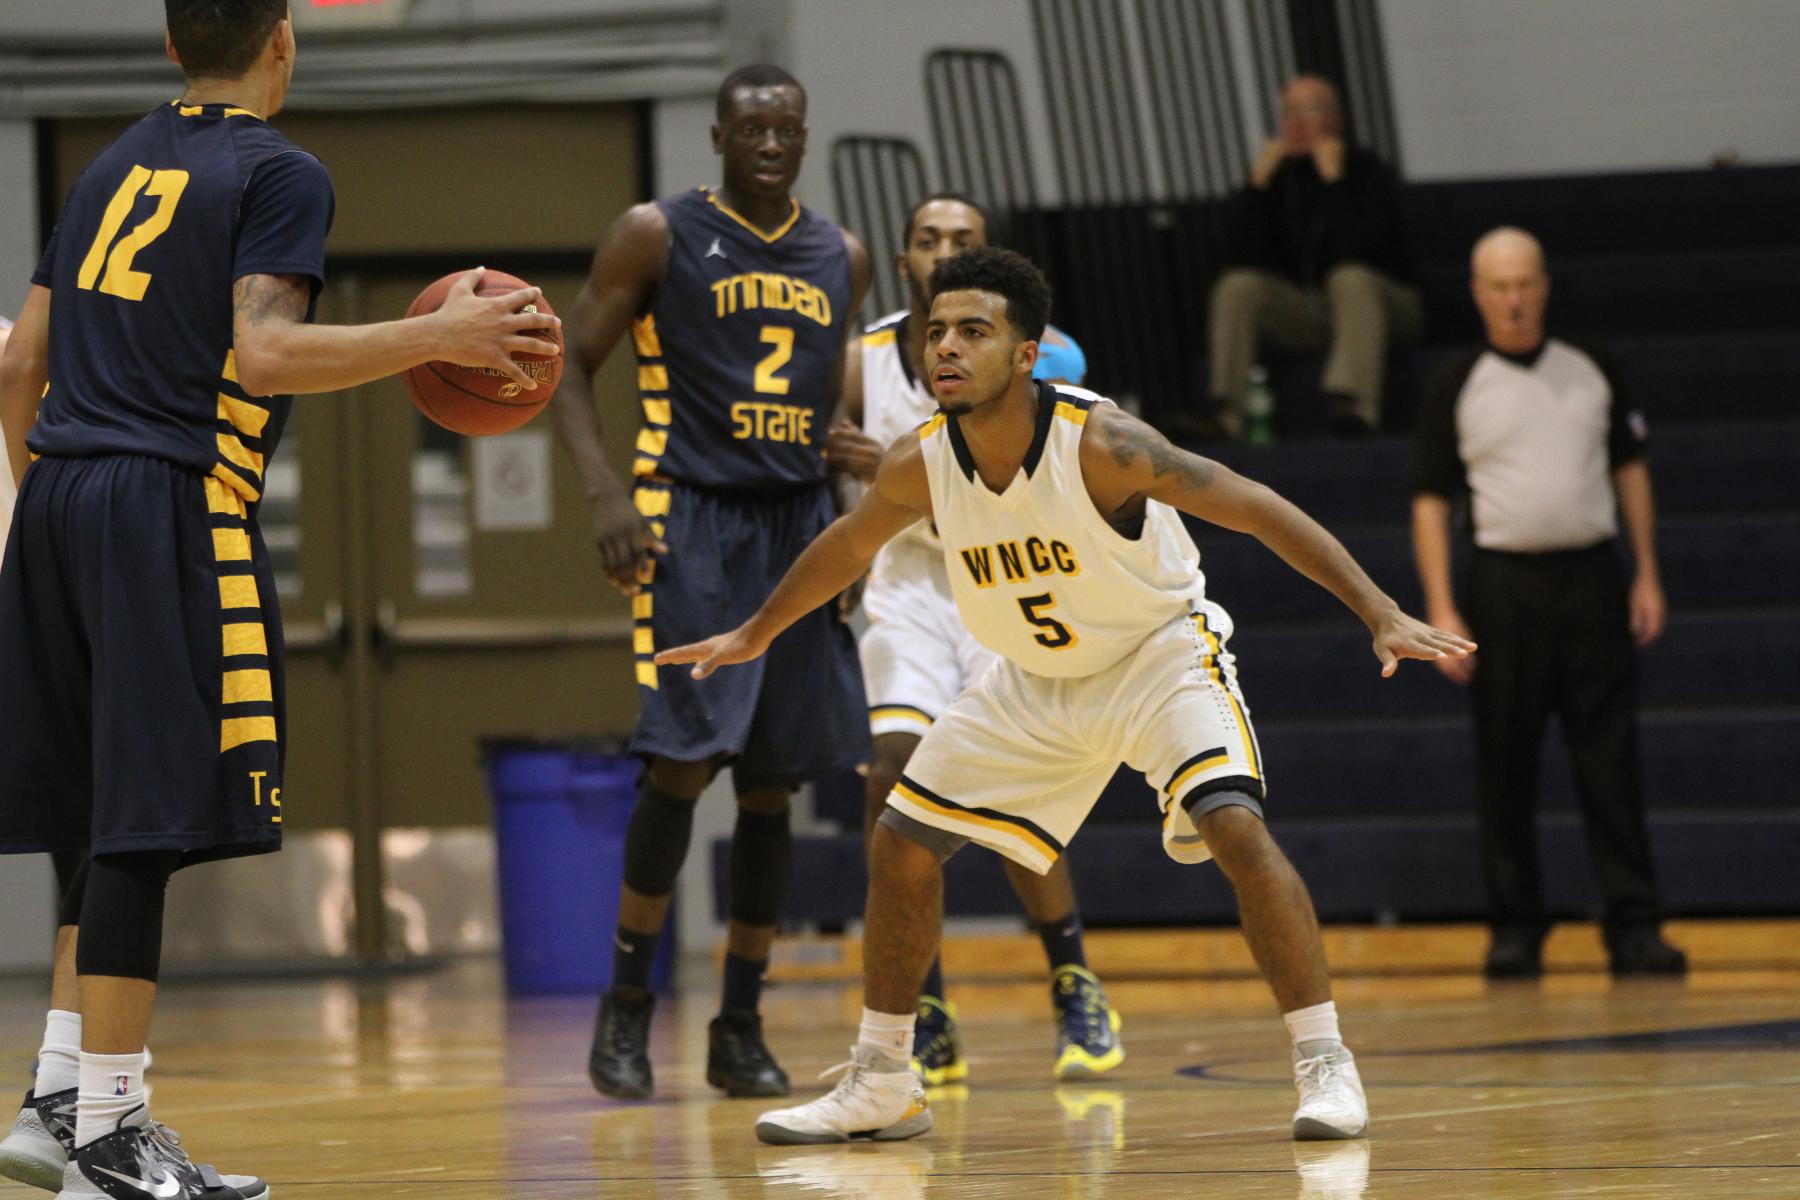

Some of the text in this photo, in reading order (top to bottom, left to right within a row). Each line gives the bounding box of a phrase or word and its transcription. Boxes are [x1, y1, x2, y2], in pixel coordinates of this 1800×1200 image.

[77, 164, 190, 302] 12
[710, 271, 832, 327] TRINIDAD
[754, 326, 795, 395] 2
[730, 401, 814, 446] STATE
[959, 535, 1081, 589] WNCC
[1016, 591, 1079, 651] 5
